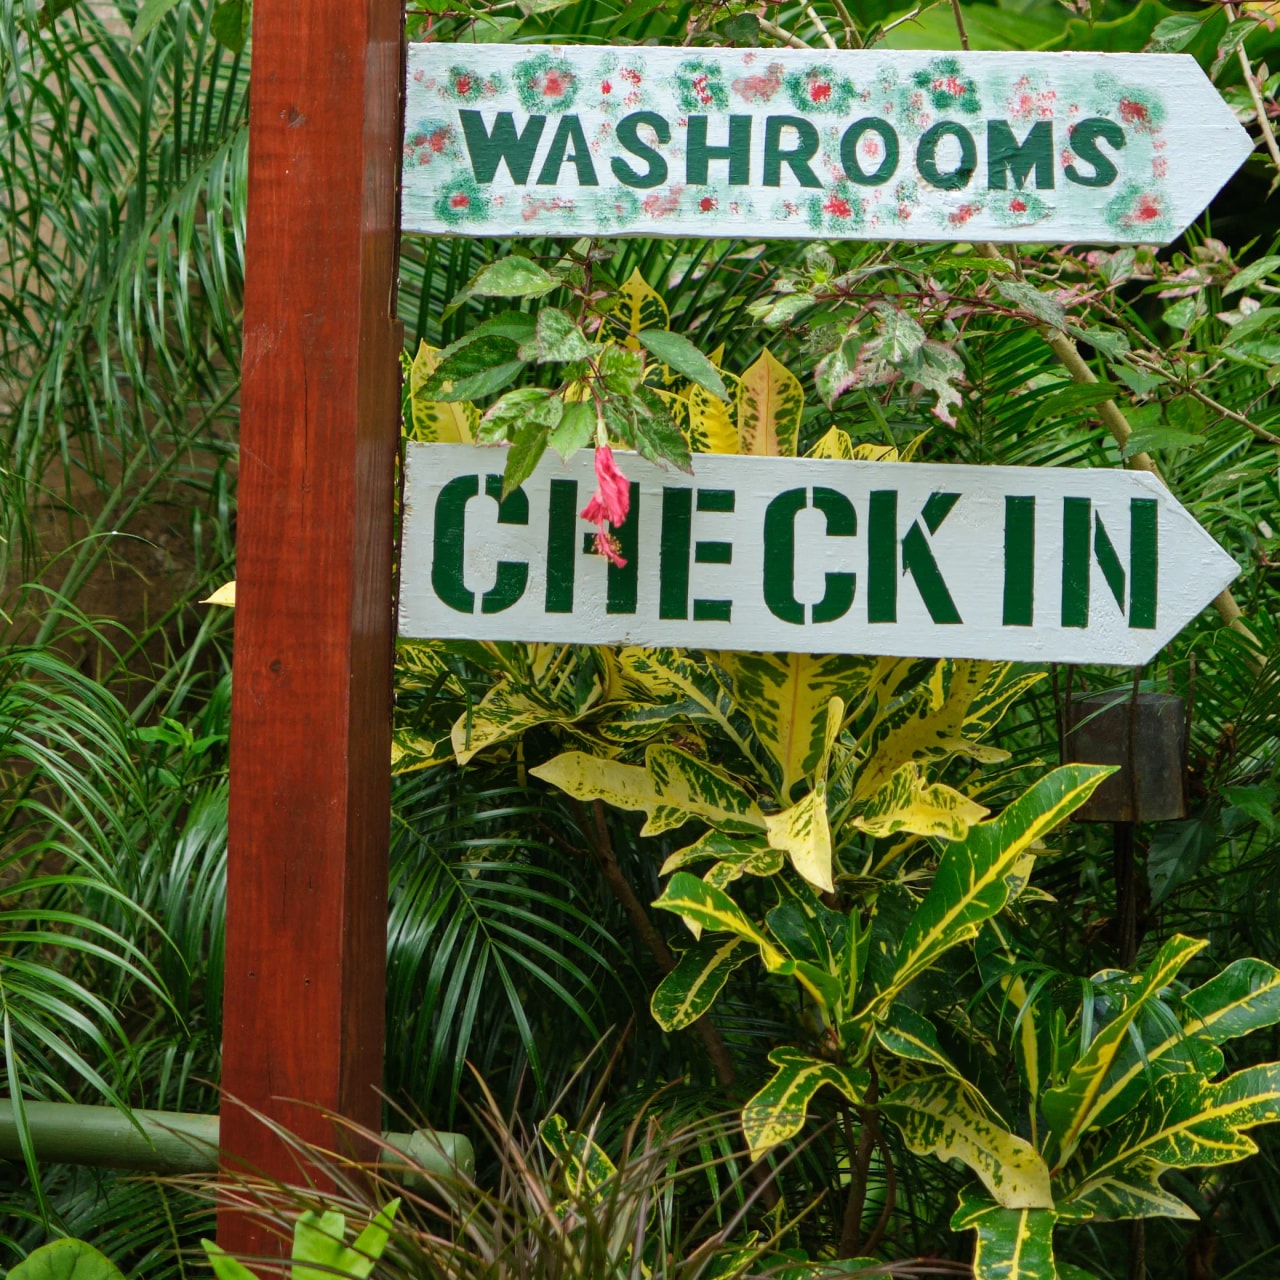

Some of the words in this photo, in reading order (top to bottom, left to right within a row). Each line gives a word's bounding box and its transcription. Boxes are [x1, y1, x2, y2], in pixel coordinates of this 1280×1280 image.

[458, 109, 1126, 190] WASHROOMS
[432, 474, 962, 625] CHECK
[1002, 495, 1158, 629] IN
